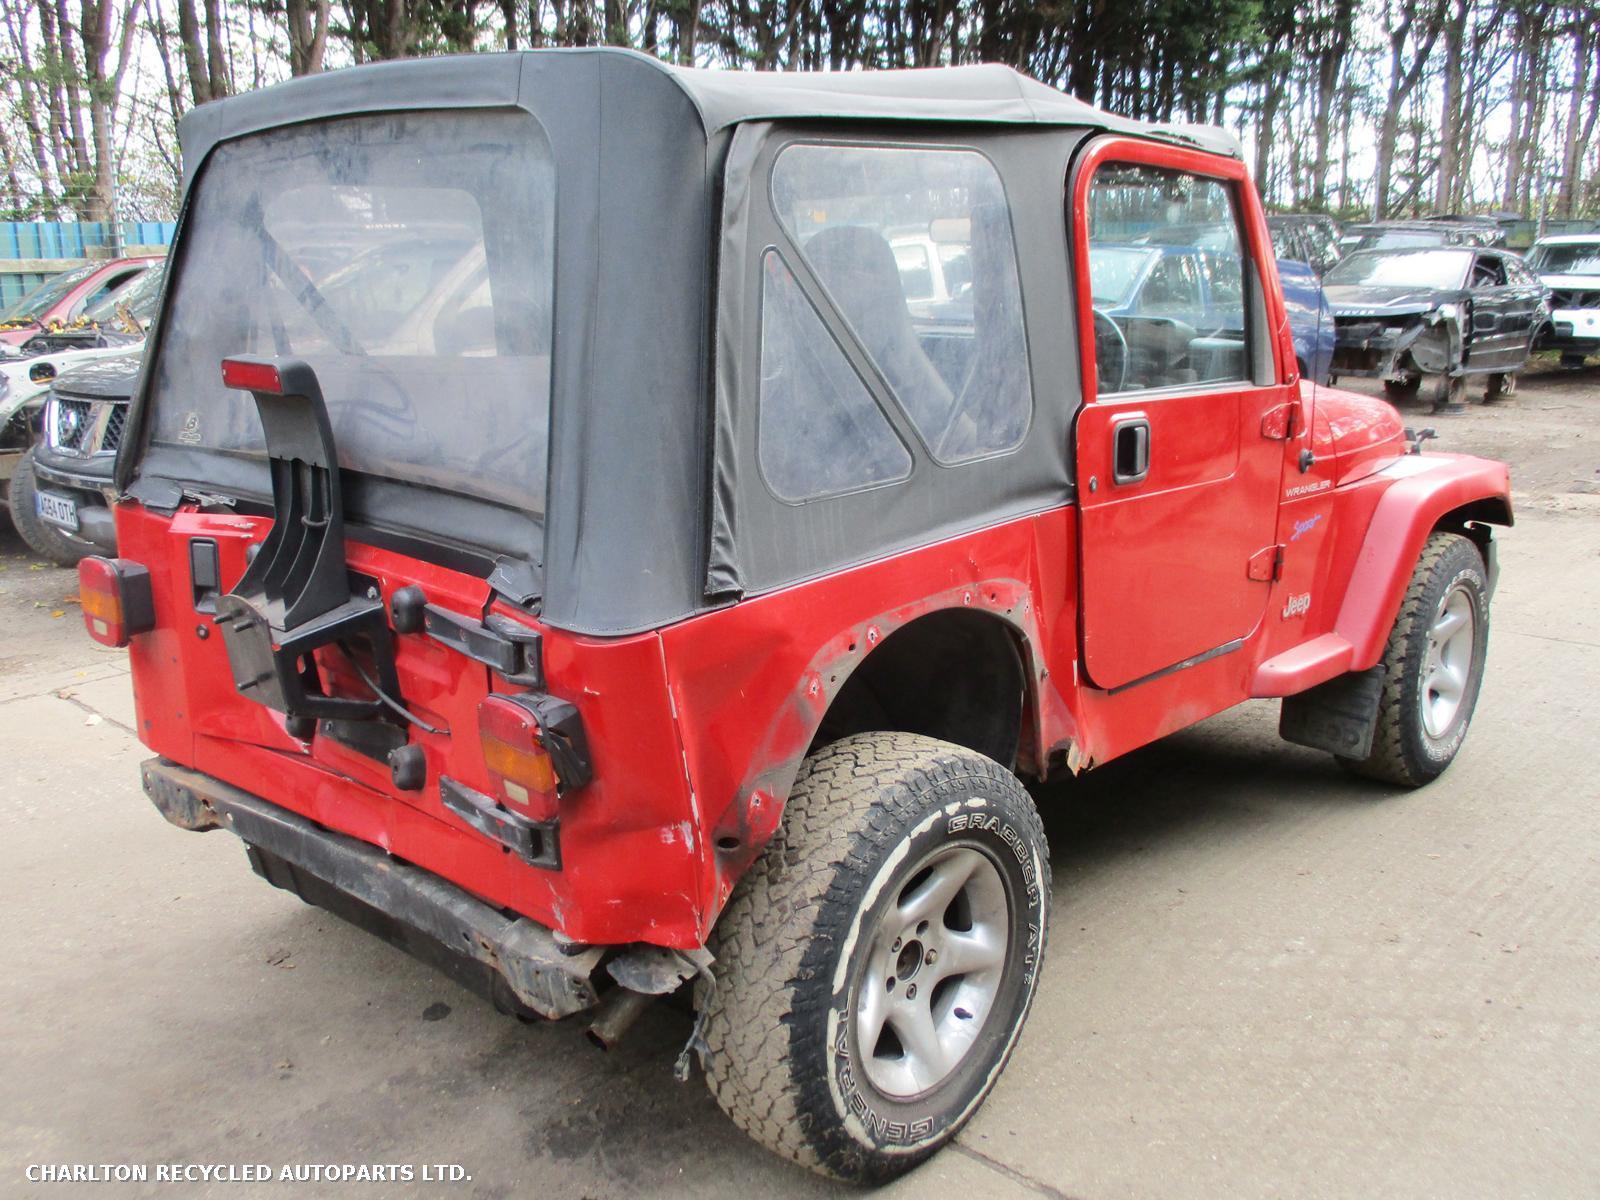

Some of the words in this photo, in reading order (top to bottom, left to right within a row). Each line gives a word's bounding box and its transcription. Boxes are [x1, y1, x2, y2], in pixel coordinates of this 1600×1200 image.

[1286, 479, 1331, 497] WRANGLER
[1283, 593, 1310, 618] Jeep
[948, 812, 1041, 910] GRABBER
[836, 986, 934, 1142] GENERAL
